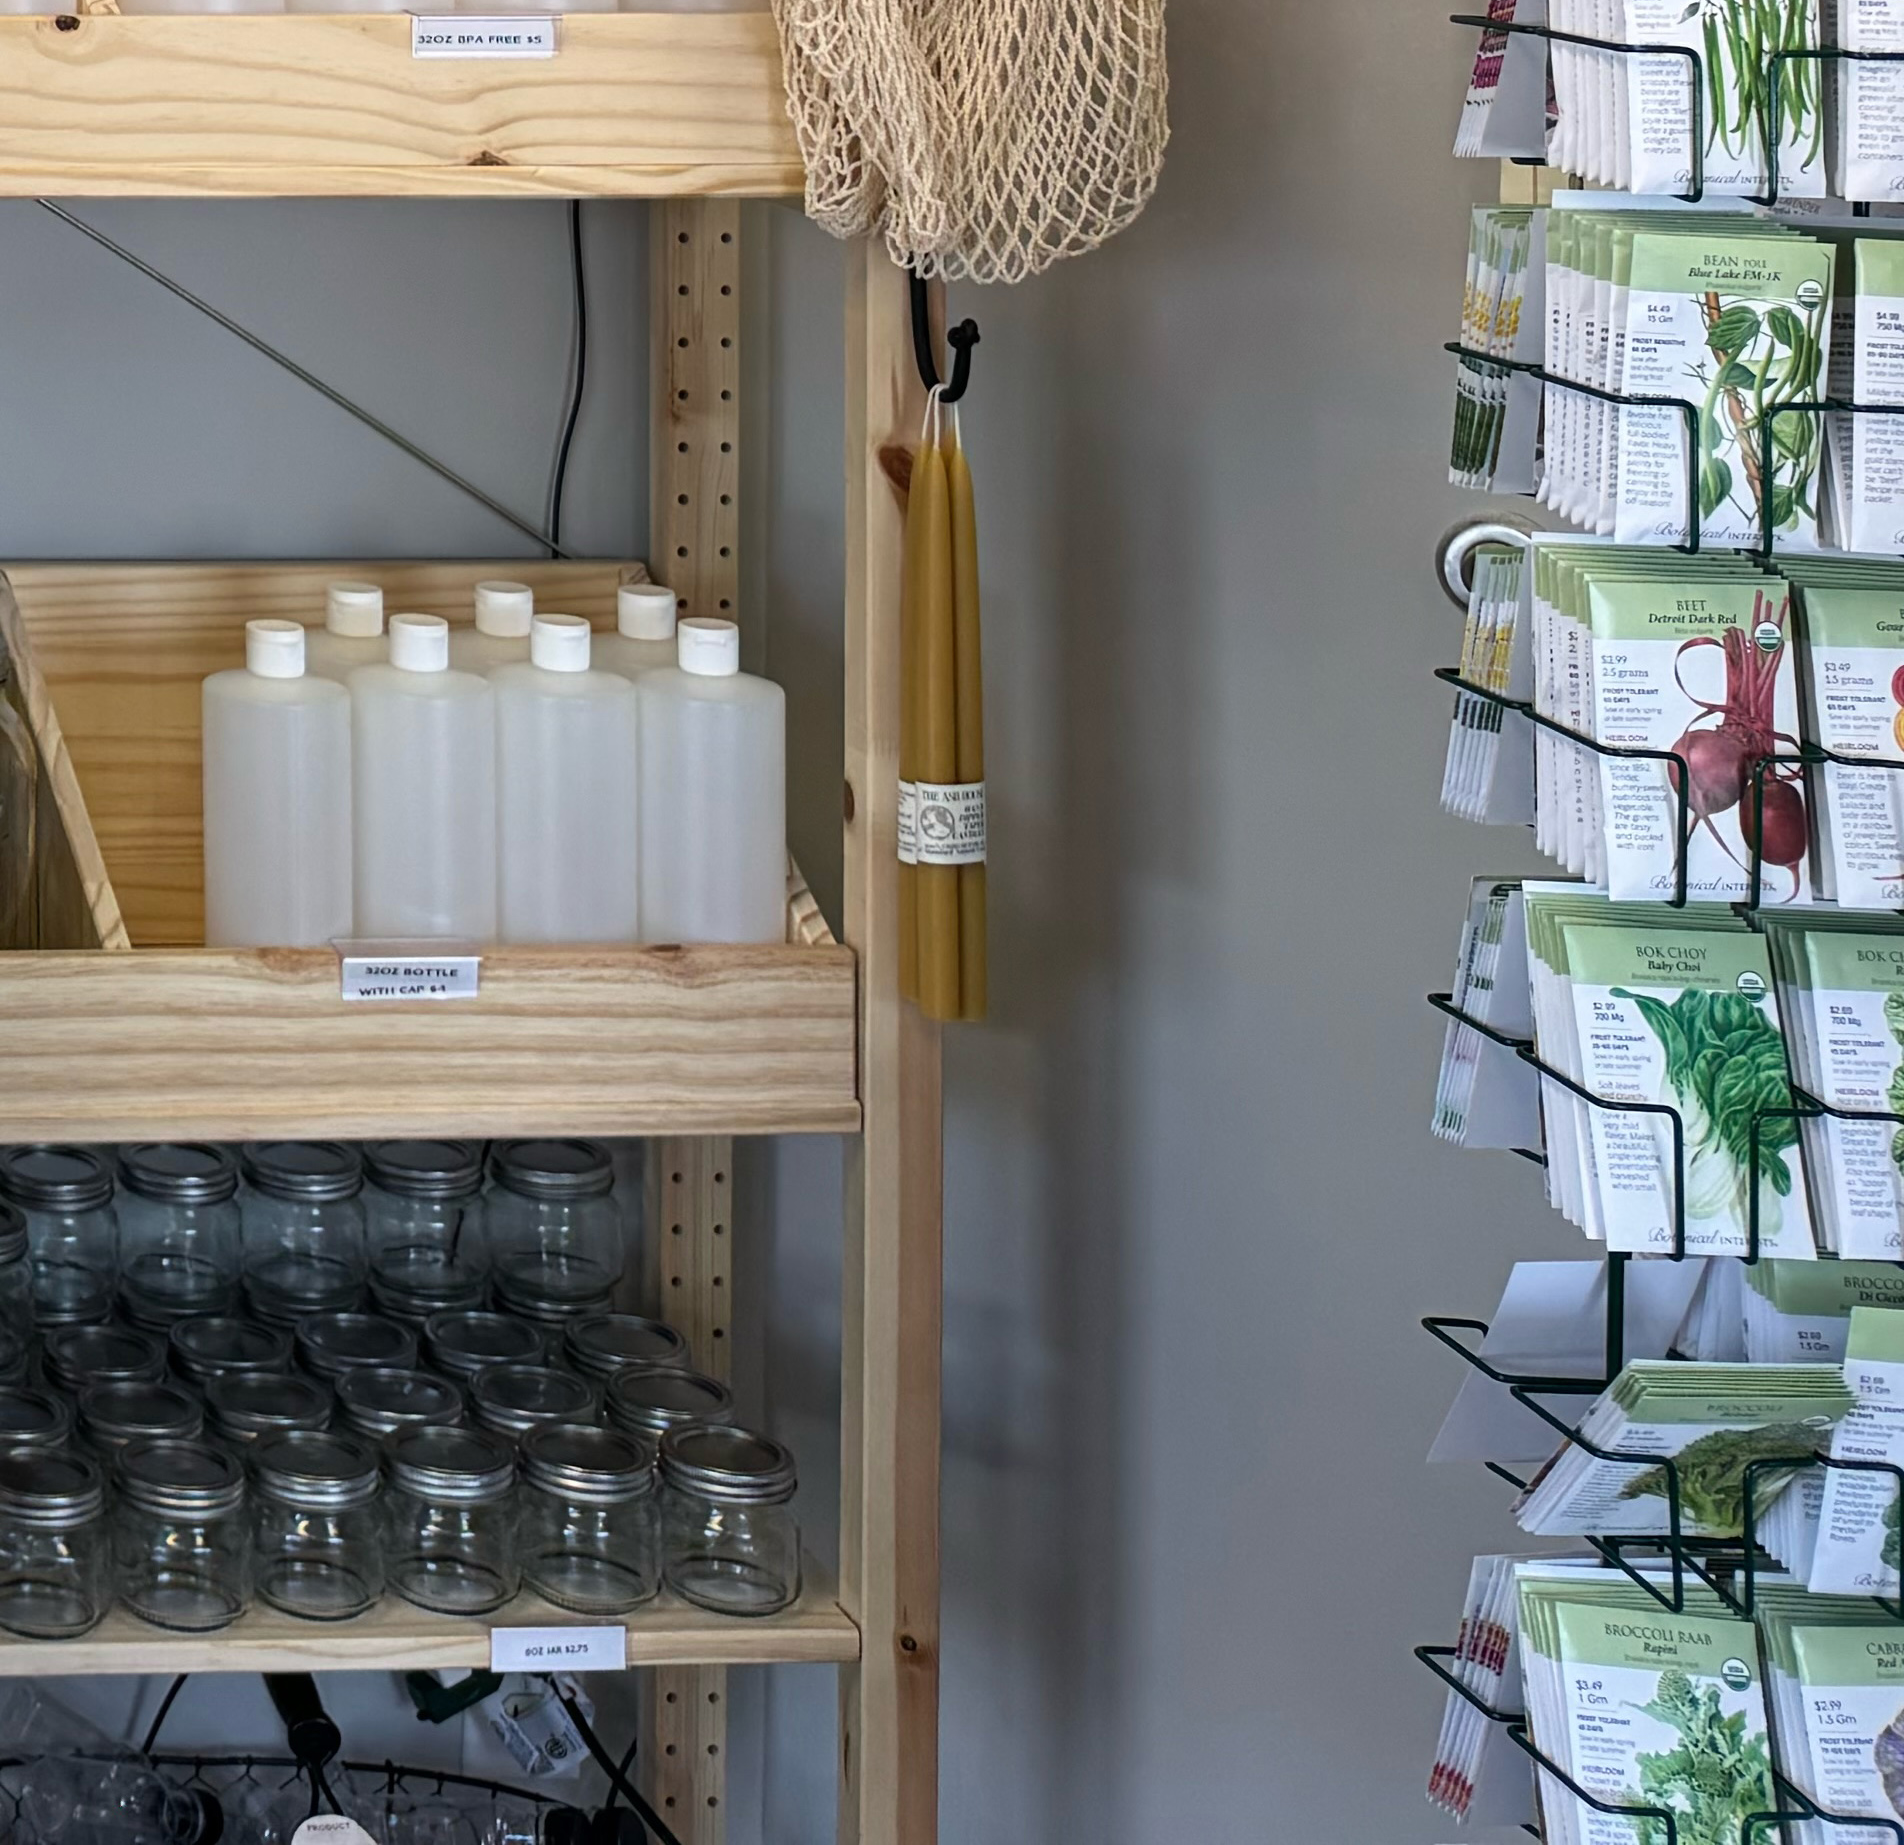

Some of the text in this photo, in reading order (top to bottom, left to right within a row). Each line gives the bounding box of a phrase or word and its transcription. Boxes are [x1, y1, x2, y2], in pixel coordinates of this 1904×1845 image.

[457, 35, 484, 45] BPA
[488, 35, 521, 45] FREE
[1703, 255, 1739, 267] BEAN
[1688, 267, 1712, 279] Blue
[1715, 269, 1741, 279] Lake
[1677, 599, 1706, 612] BEET
[1648, 613, 1737, 625] Detroit Dark Red
[1636, 946, 1707, 960] BOK CHOY
[1857, 949, 1885, 962] BOK
[403, 968, 458, 977] BOTTLE
[1648, 960, 1674, 973] Baby
[359, 986, 395, 997] WITH
[1604, 1623, 1713, 1646] BROCCOLI RAAB
[1836, 1714, 1857, 1725] Gm
[307, 1822, 350, 1832] PRODUCT
